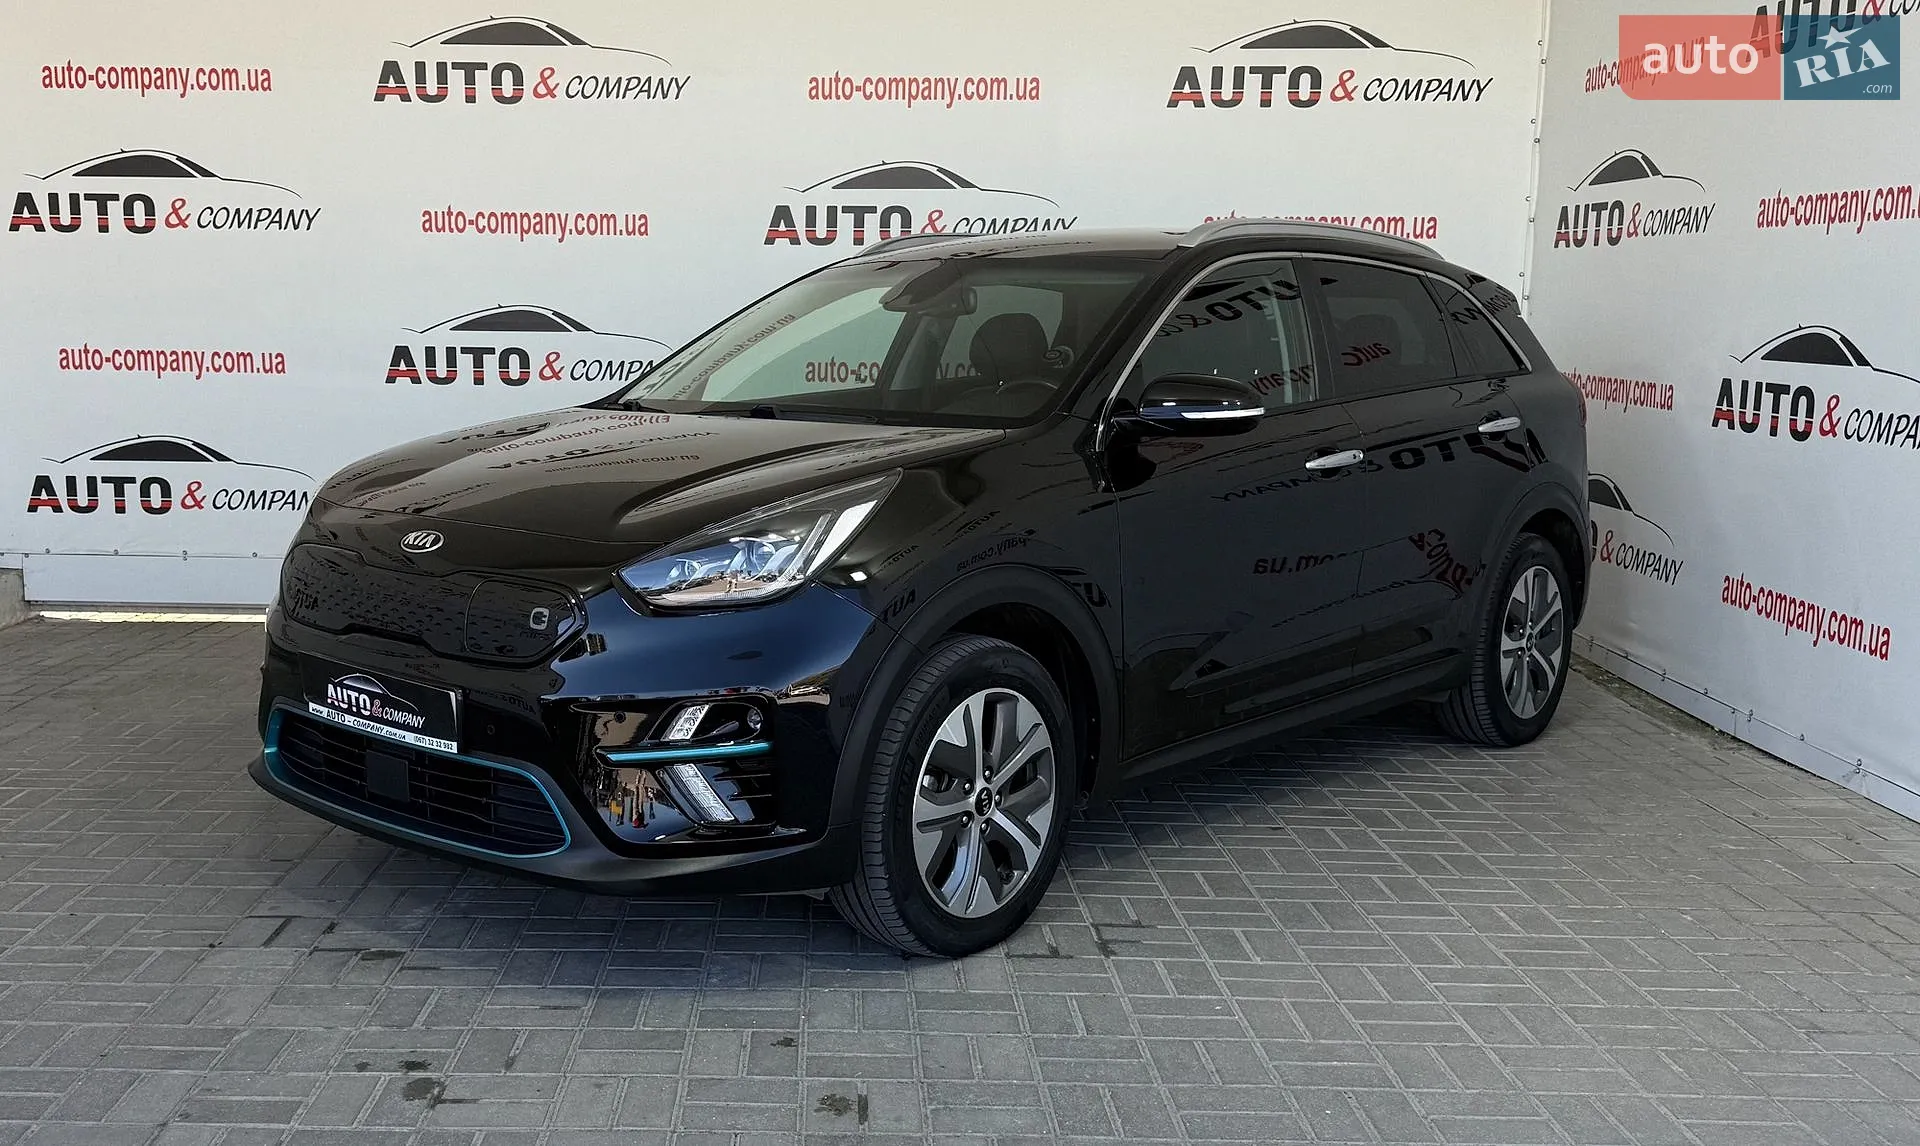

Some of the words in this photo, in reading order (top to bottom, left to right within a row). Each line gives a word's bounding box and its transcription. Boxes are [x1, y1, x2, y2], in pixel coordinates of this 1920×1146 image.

[42, 60, 271, 98] auto-company.com.ua
[374, 61, 524, 104] AUTO
[533, 67, 559, 98] &
[566, 76, 690, 100] COMPANY
[809, 71, 1039, 108] auto-company.com.ua
[1167, 66, 1322, 108] AUTO
[1330, 70, 1357, 102] &
[1364, 78, 1493, 102] COMPANY
[9, 192, 156, 234] AUTO
[165, 199, 191, 228] &
[197, 207, 321, 230] COMPANY
[422, 205, 648, 243] auto-company.com.ua
[764, 205, 912, 246] AUTO
[1554, 200, 1624, 248] AUTO
[1627, 202, 1641, 238] &
[1643, 203, 1715, 236] COMPANY
[60, 343, 285, 380] auto-company.com.ua
[385, 346, 530, 386] AUTO
[539, 352, 565, 380] &
[1712, 378, 1815, 441] AUTO
[1819, 395, 1841, 438] &
[1844, 408, 1920, 449] COMPA
[27, 475, 172, 515] AUTO
[181, 481, 206, 510] &
[404, 531, 436, 548] KIA
[1600, 530, 1614, 563] &
[1616, 543, 1683, 585] COMPANY
[1722, 573, 1890, 660] auto-company.com.ua
[326, 710, 346, 723] AUTO
[327, 683, 371, 716] AUTO
[371, 699, 382, 718] &
[383, 706, 426, 729] COMPANY
